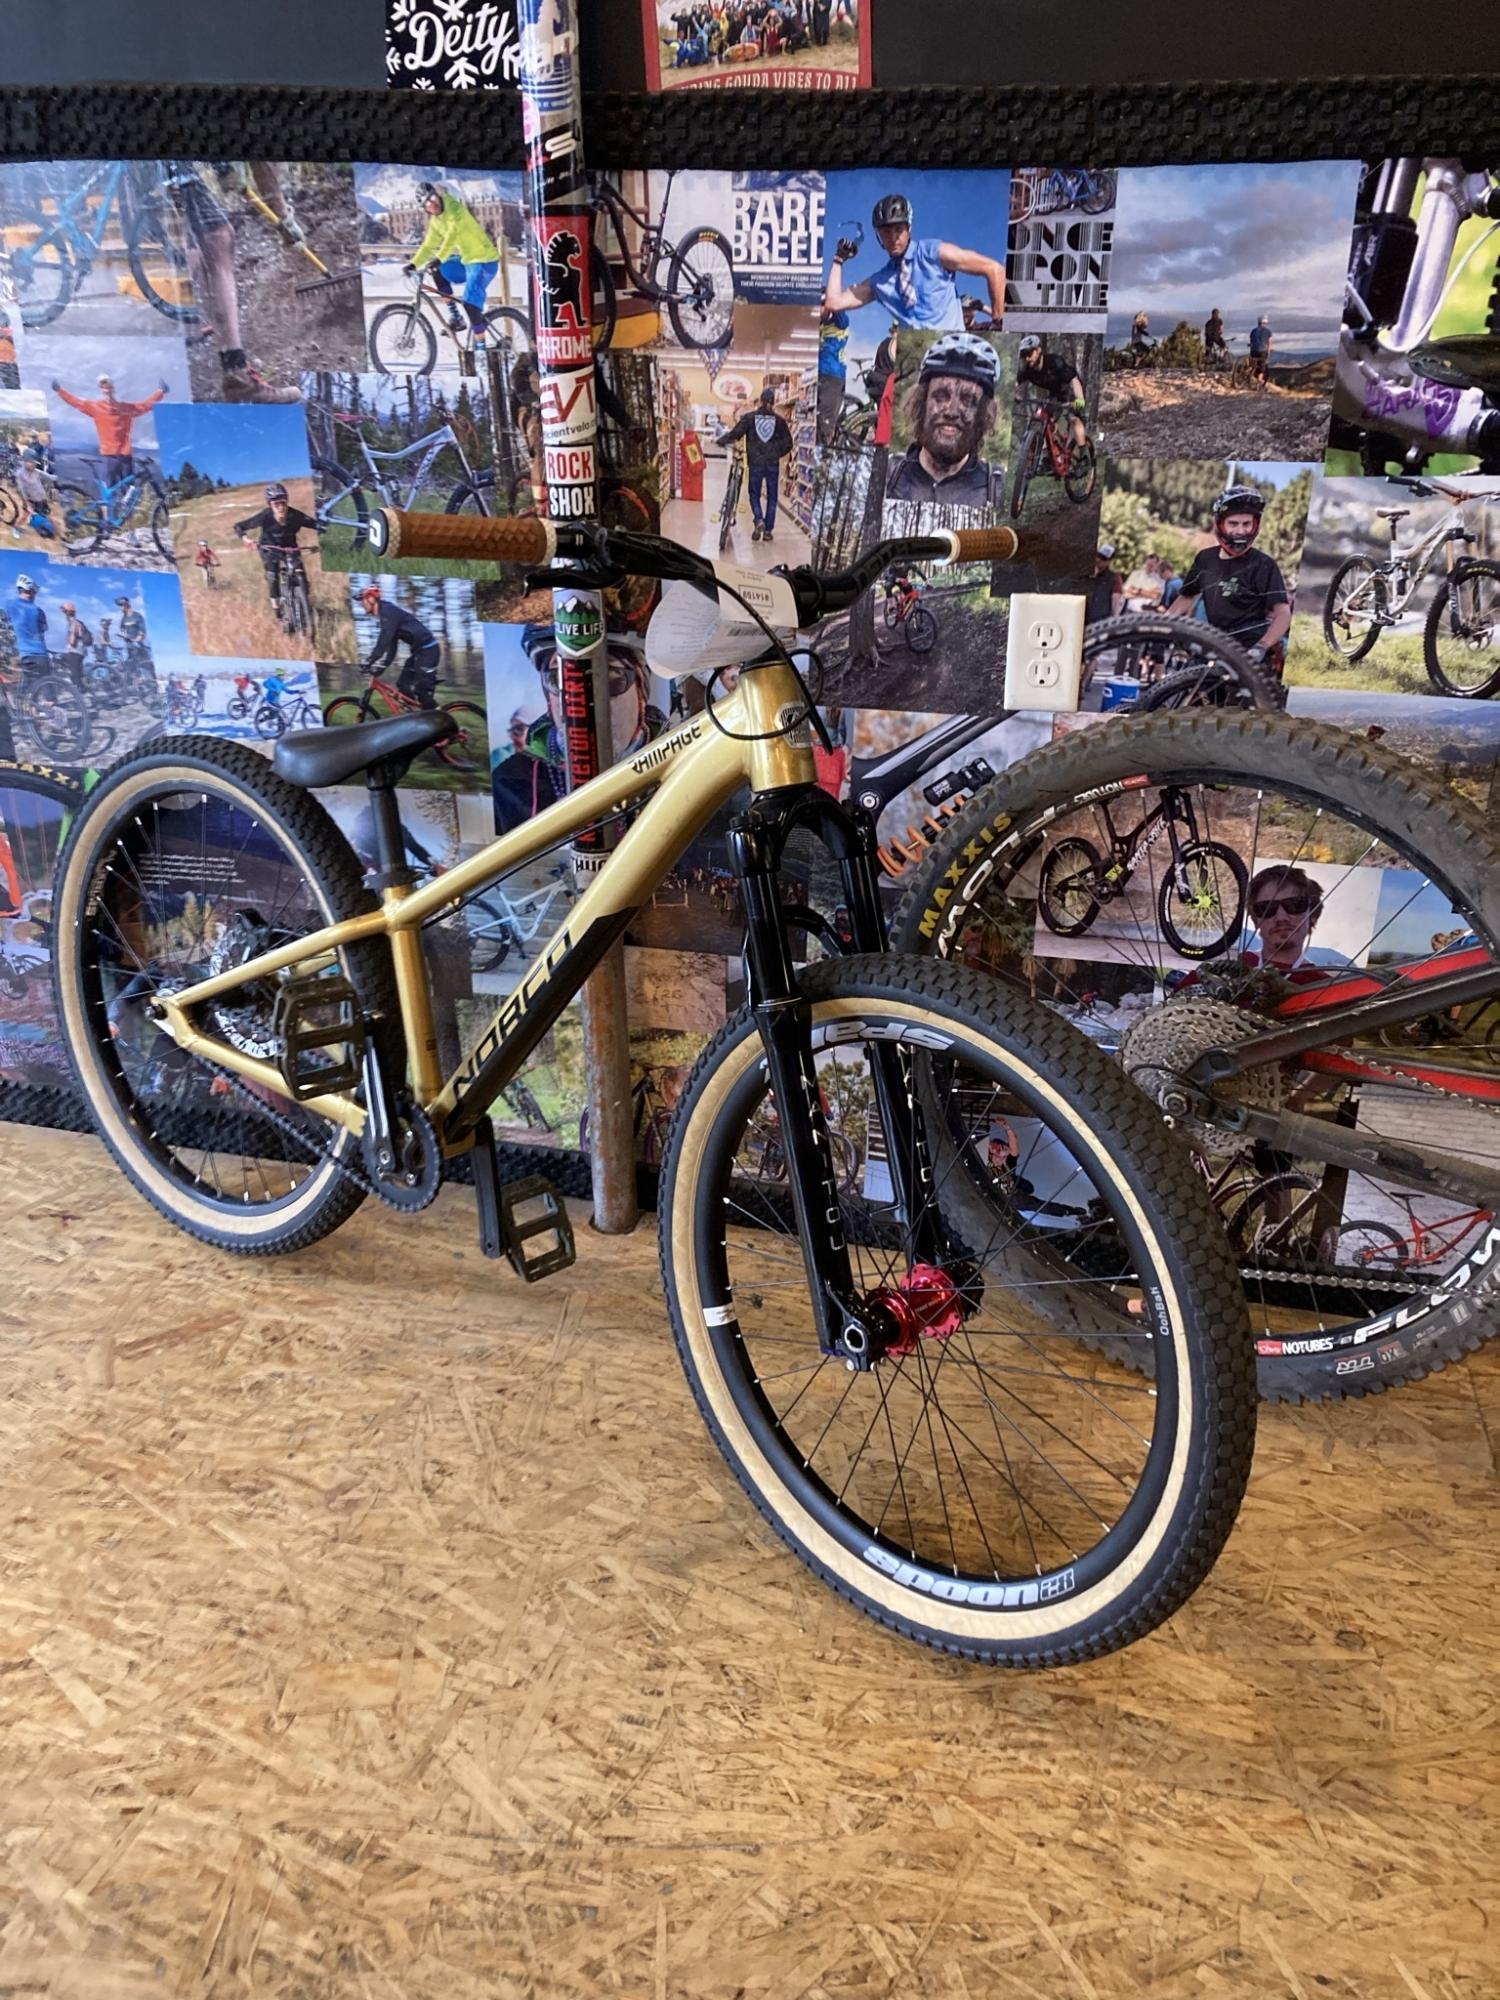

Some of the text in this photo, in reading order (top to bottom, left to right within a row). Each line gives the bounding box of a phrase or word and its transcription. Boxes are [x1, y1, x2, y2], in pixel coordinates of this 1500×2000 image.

[404, 2, 516, 75] Deity
[773, 72, 812, 88] VIBES
[816, 73, 832, 89] TO
[732, 191, 826, 235] RARE
[1007, 222, 1114, 252] ONCE
[1005, 253, 1112, 281] UPON
[1037, 283, 1108, 306] TIME
[537, 335, 593, 361] CHROME
[548, 450, 592, 481] ROCK
[550, 486, 595, 517] SHOX
[918, 812, 1012, 939] MAXXIS
[453, 927, 574, 1099] NORCO
[1282, 1335, 1334, 1355] NOTUBES
